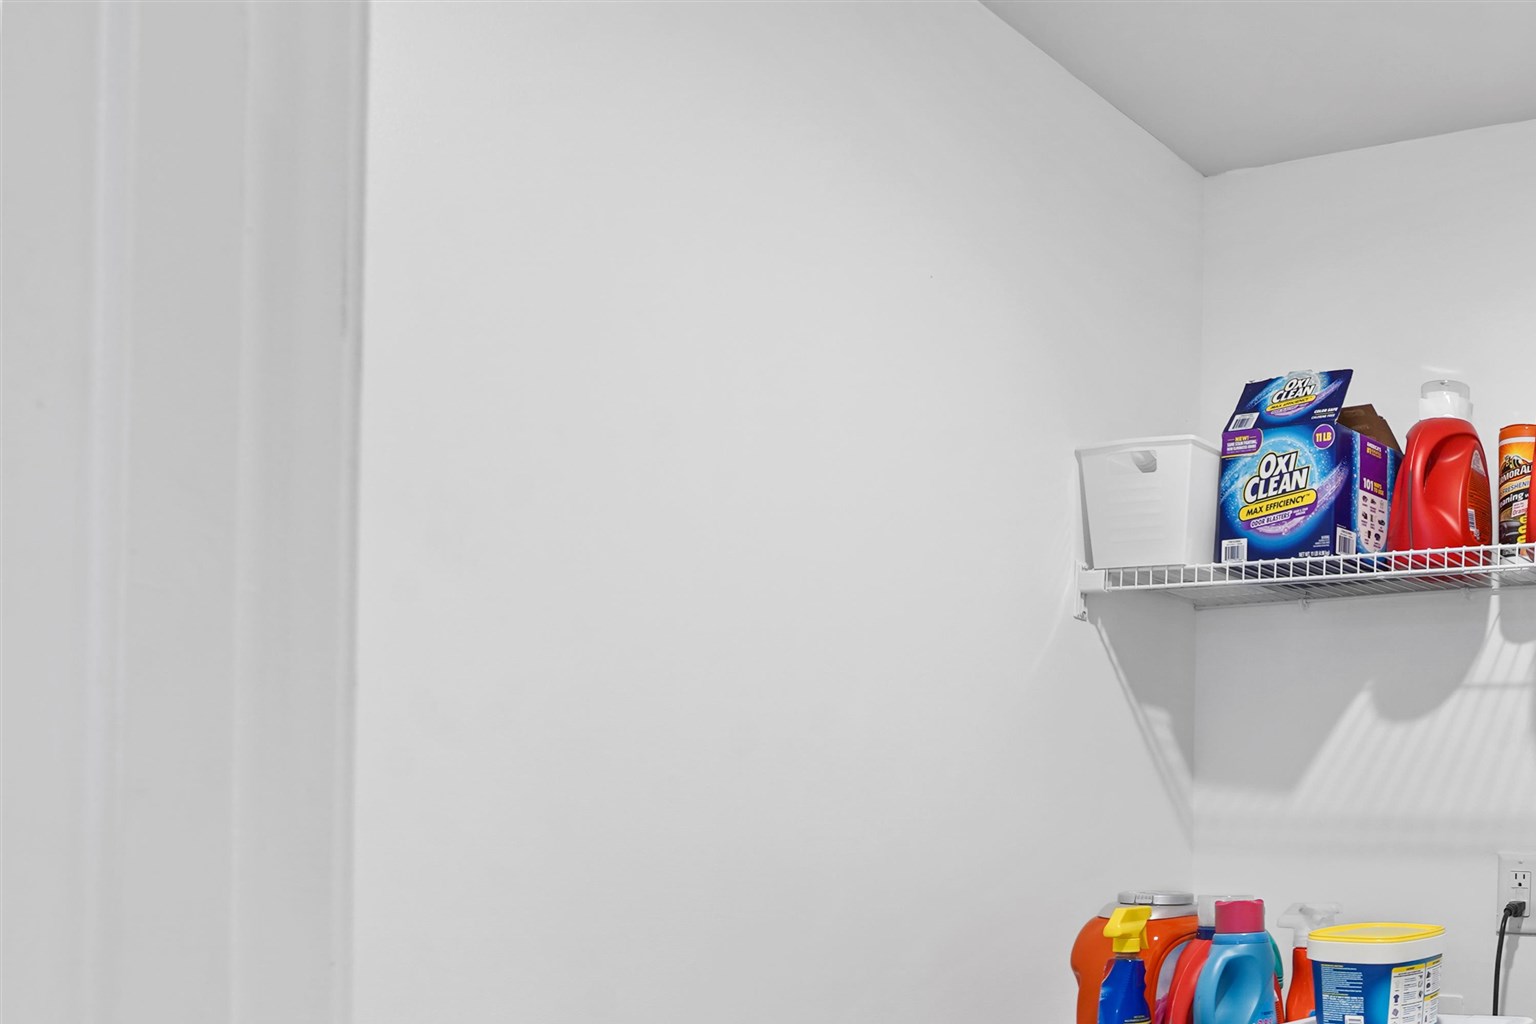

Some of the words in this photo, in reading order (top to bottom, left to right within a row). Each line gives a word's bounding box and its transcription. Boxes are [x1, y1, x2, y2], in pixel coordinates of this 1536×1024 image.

[1284, 377, 1311, 391] OXI
[1272, 384, 1316, 403] CLEAN
[1323, 432, 1332, 441] LB
[1259, 451, 1298, 479] OXI
[1244, 466, 1310, 503] CLEAN
[1362, 477, 1374, 492] 101
[1246, 505, 1264, 517] MAX
[1265, 494, 1306, 512] EFFICIENCY
[1251, 518, 1266, 528] ODOR
[1266, 511, 1291, 524] BLASTERS
